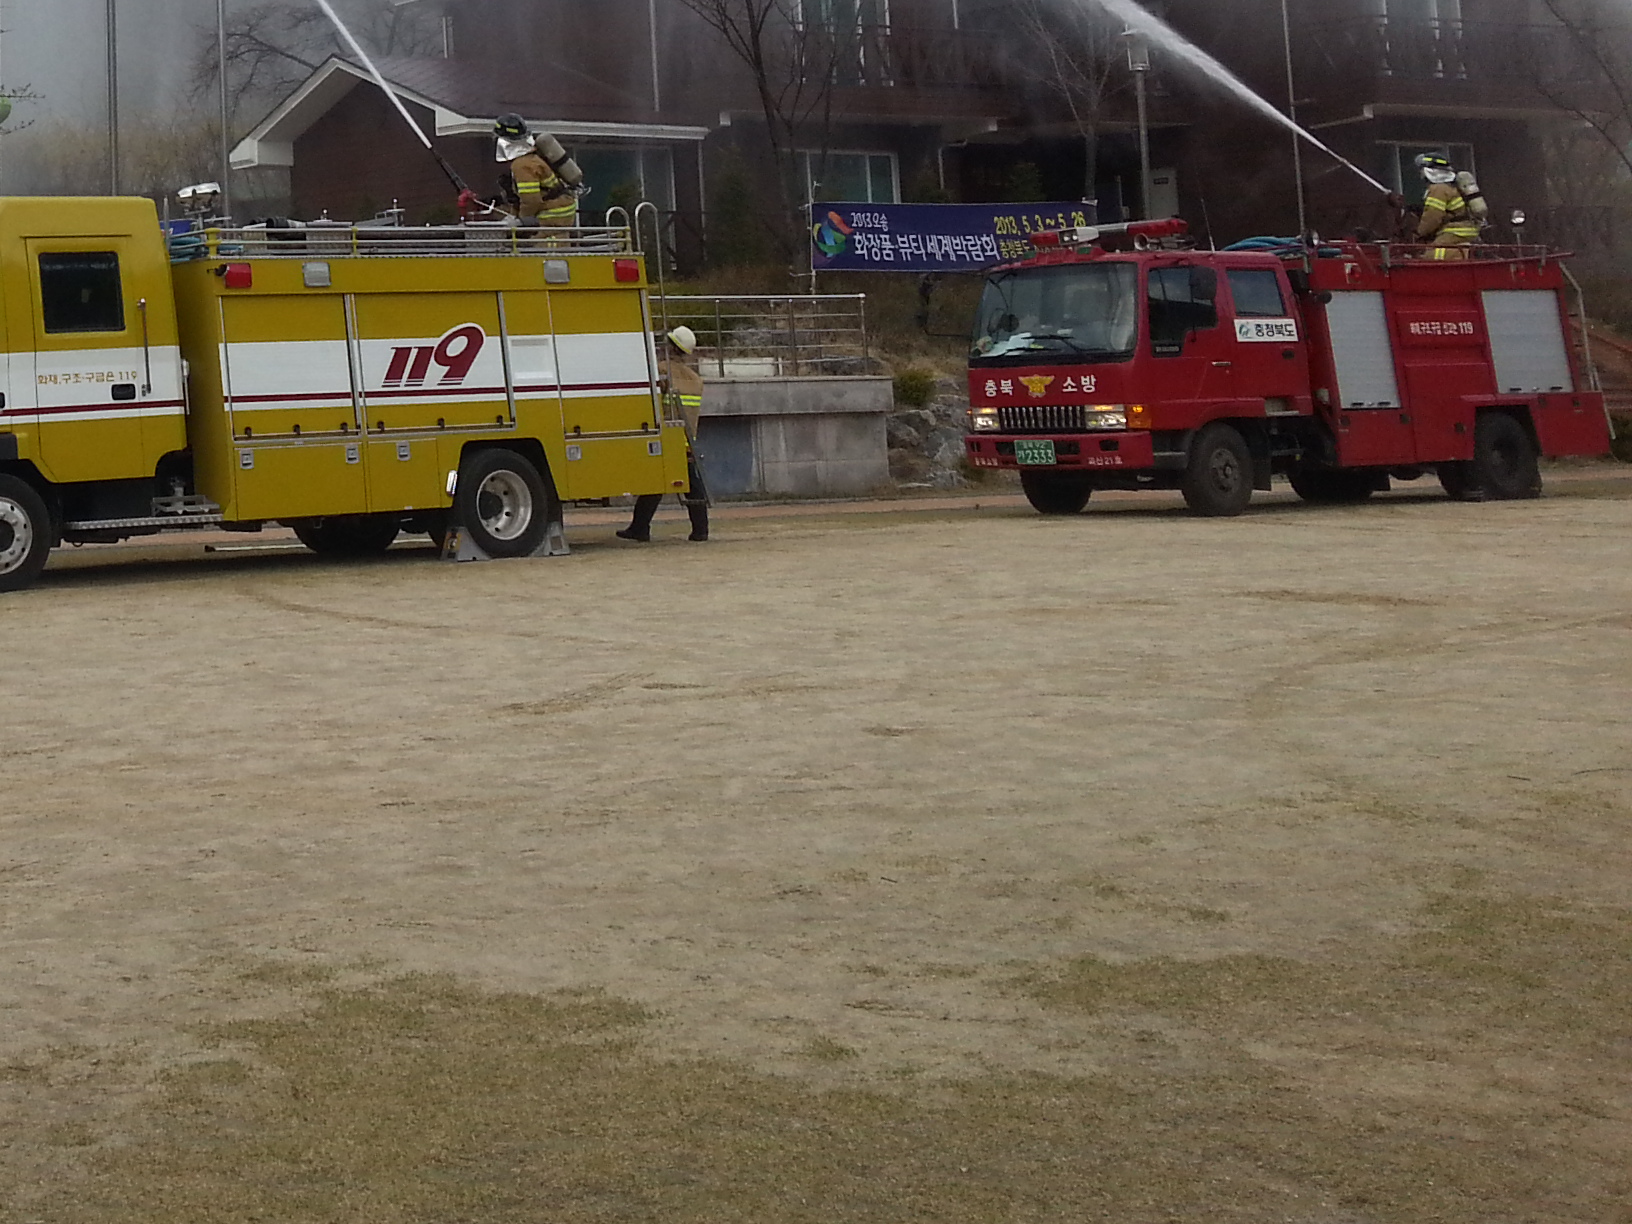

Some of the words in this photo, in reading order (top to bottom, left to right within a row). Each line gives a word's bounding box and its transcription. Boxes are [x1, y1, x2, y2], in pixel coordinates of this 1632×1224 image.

[381, 326, 485, 388] 119
[119, 371, 138, 381] 119
[984, 379, 1014, 397] 충북
[1062, 375, 1097, 393] 소방
